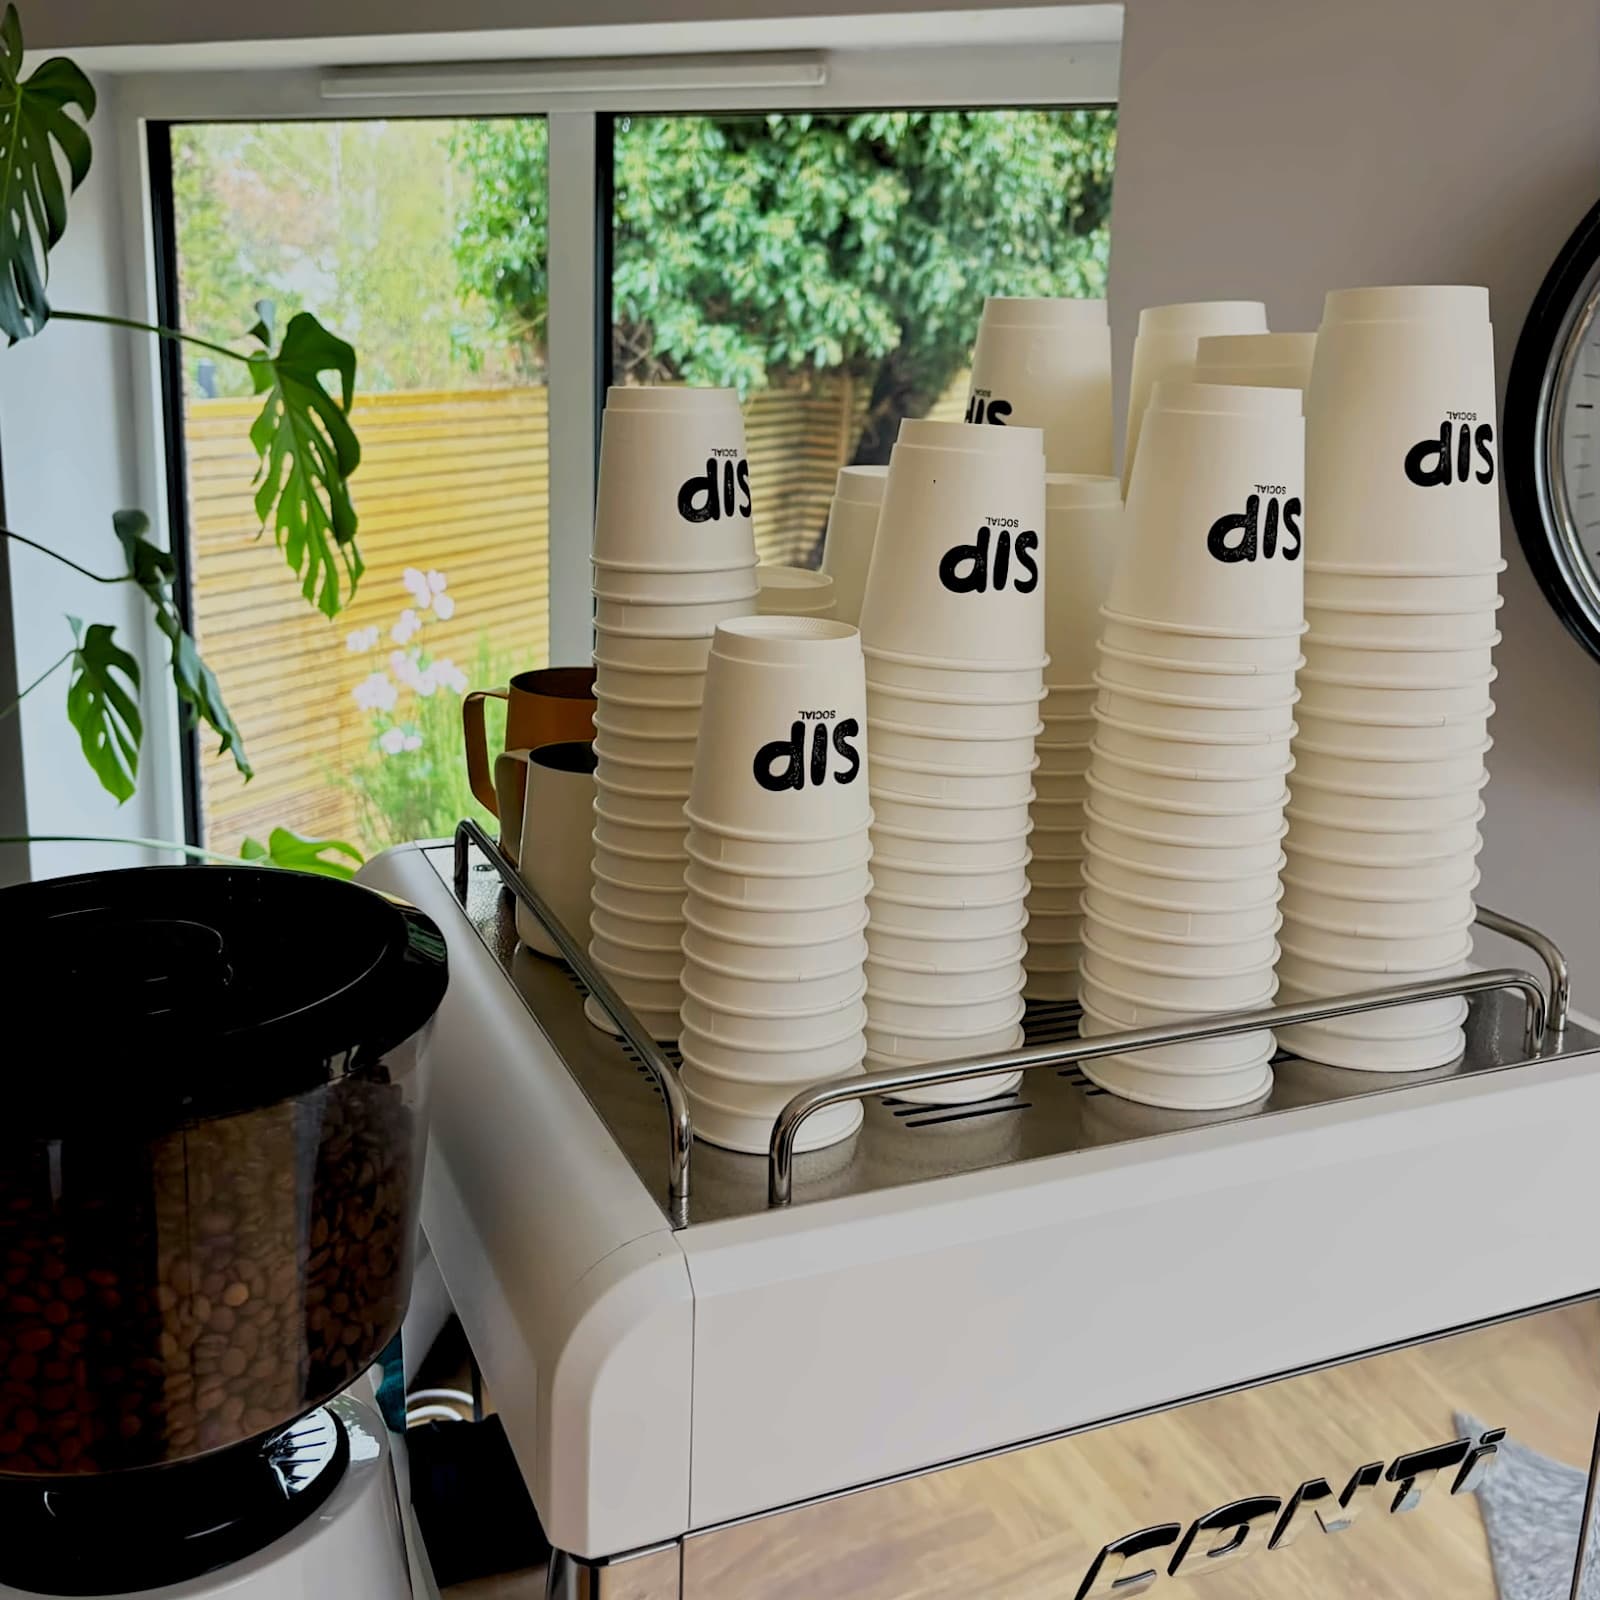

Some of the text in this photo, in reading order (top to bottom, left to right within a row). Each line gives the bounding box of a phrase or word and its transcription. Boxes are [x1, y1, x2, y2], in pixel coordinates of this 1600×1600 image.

[1446, 411, 1477, 421] SOCIAL
[1253, 484, 1287, 495] SOCIAL
[985, 516, 1019, 528] SOCIAL
[798, 710, 836, 720] SOCIAL
